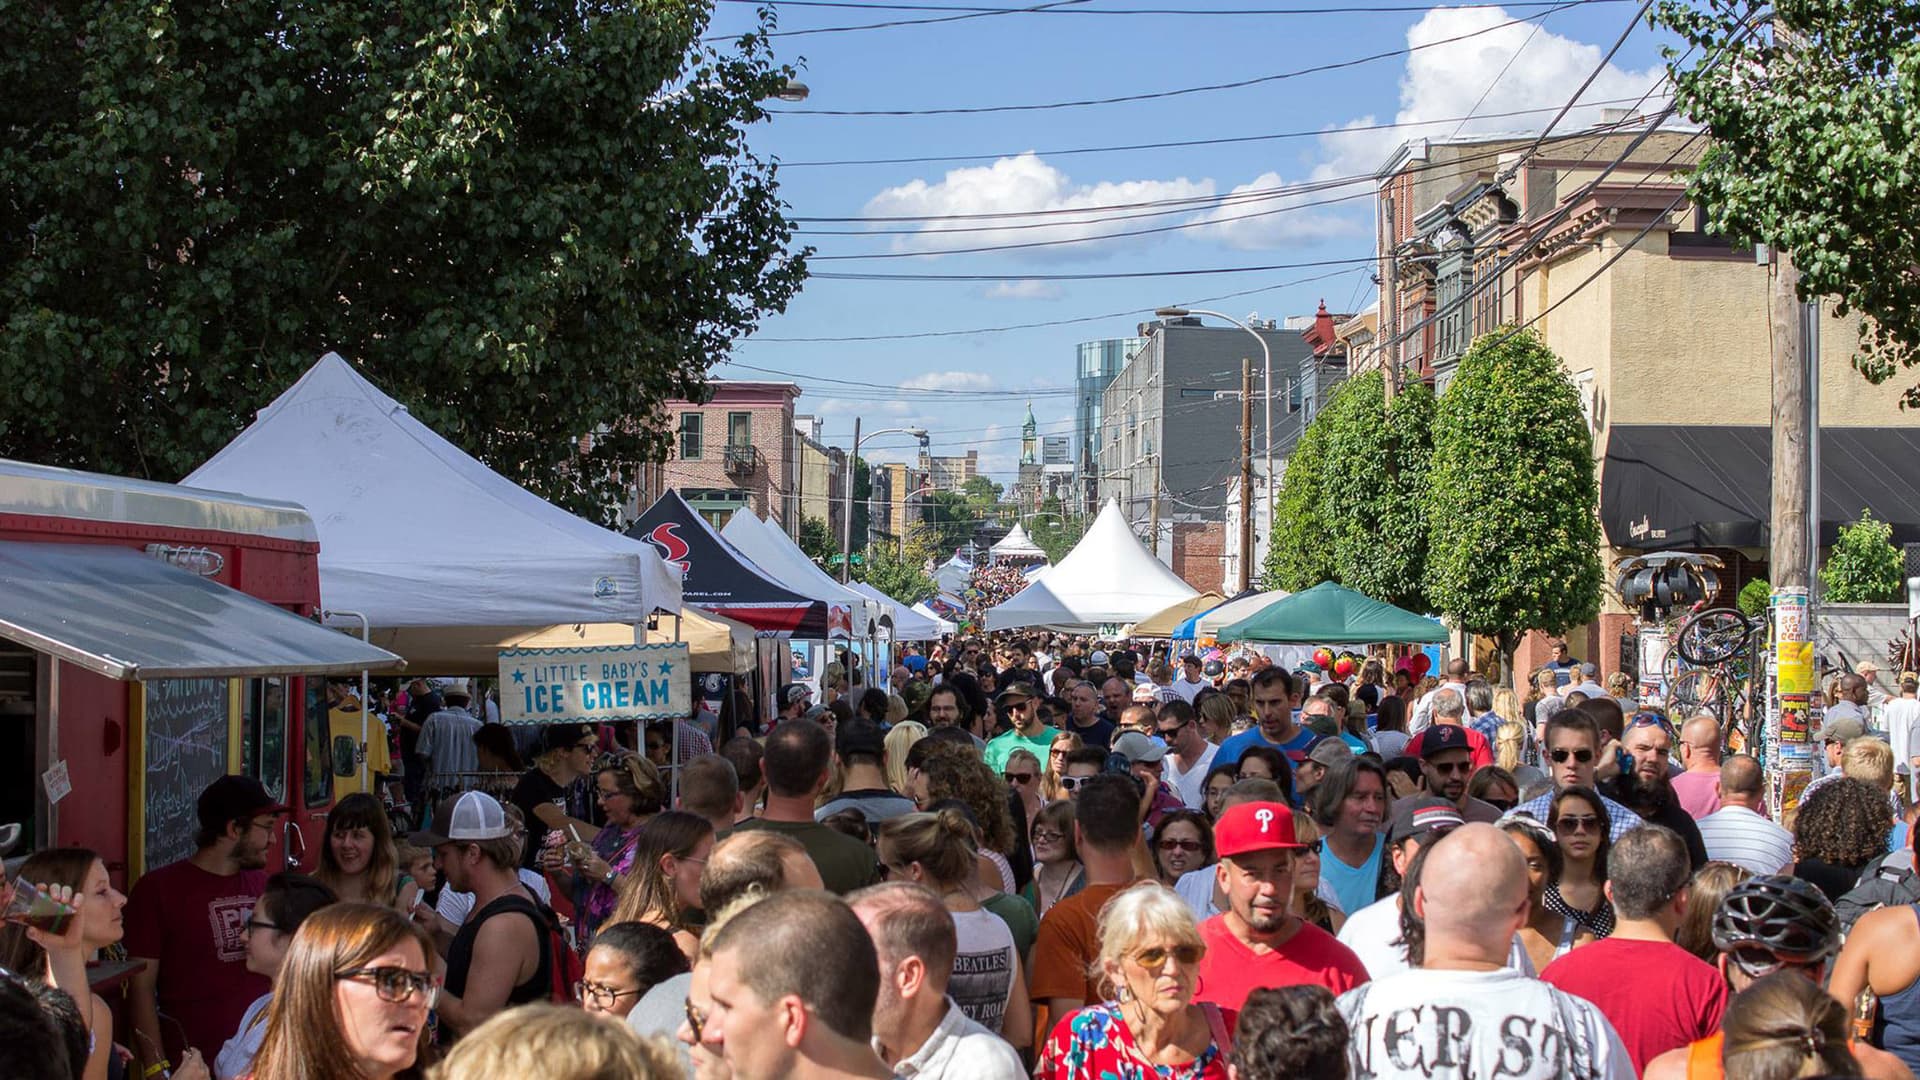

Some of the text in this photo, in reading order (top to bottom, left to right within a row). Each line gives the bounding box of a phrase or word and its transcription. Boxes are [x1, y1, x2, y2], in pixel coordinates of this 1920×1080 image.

[1101, 623, 1118, 636] M
[534, 660, 649, 683] LITTLE BABY'S
[525, 683, 564, 713] ICE
[582, 678, 669, 711] CREAM
[1255, 808, 1274, 833] P
[953, 953, 1006, 972] BEATLES
